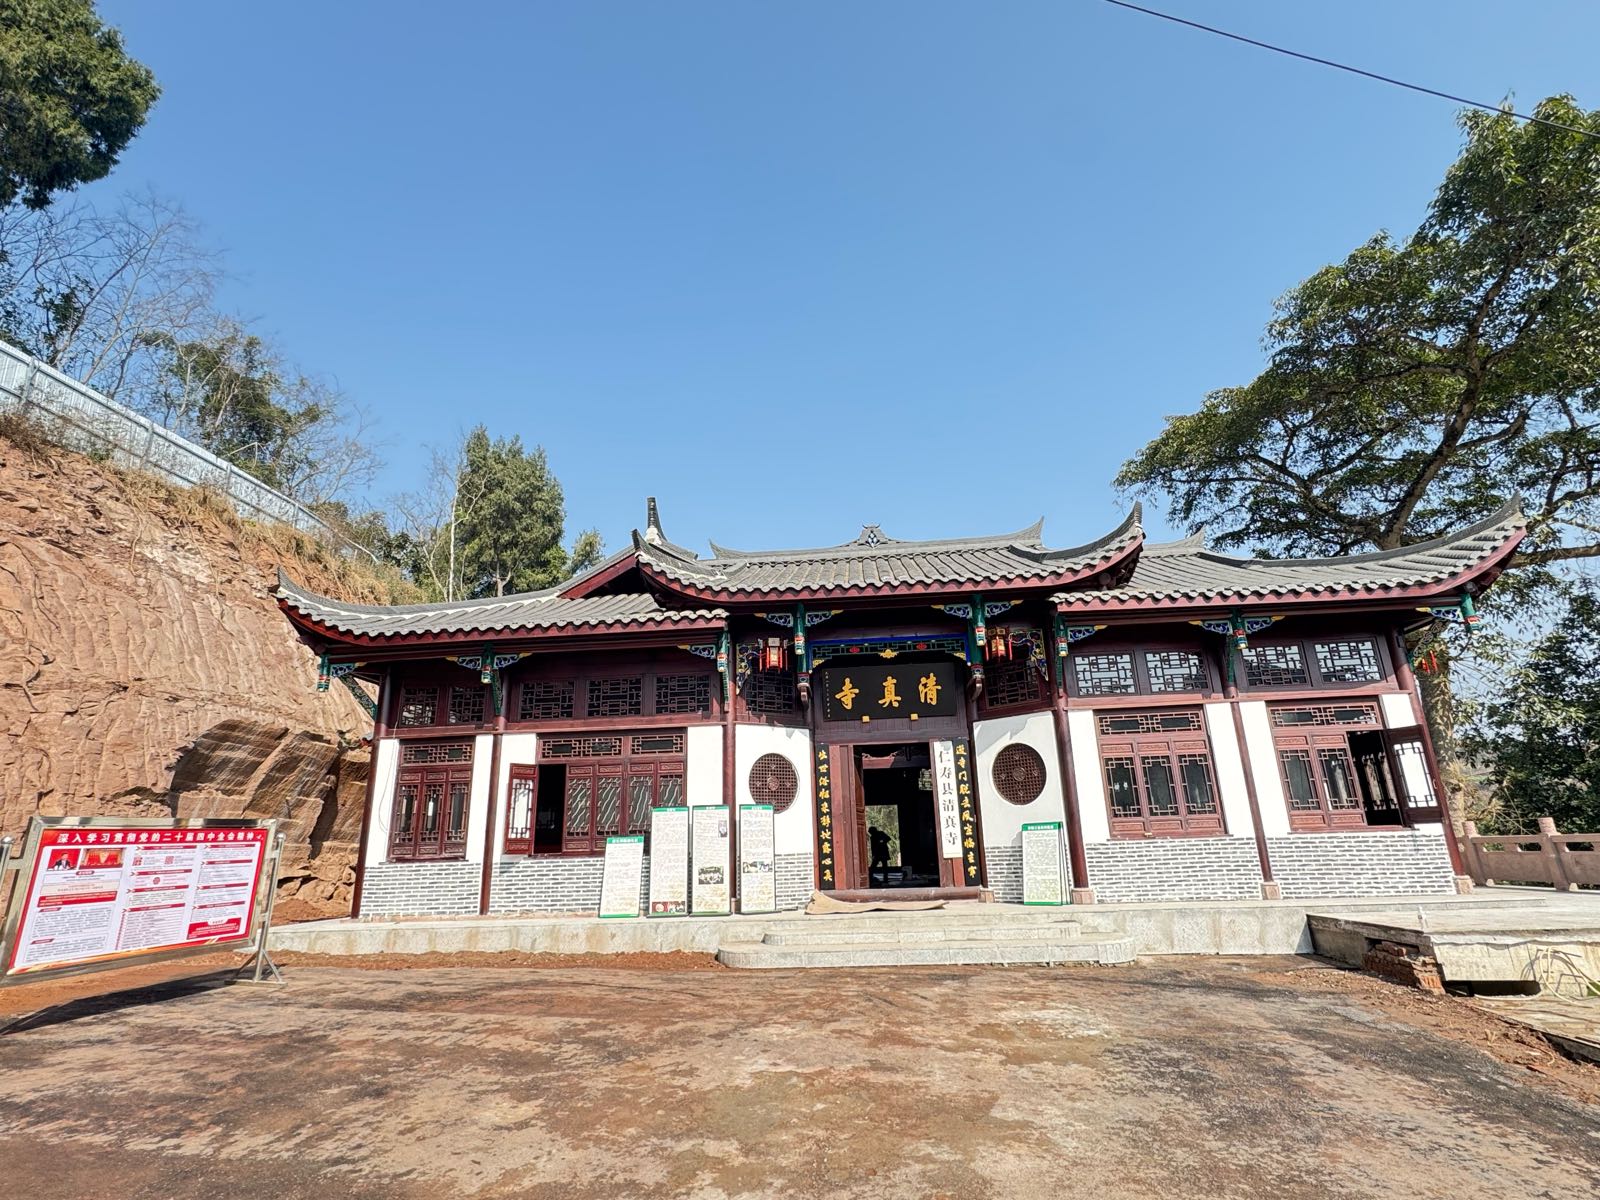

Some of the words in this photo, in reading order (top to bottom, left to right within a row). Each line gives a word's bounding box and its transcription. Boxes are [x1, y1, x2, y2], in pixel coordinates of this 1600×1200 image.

[834, 672, 943, 710] 清真寺
[939, 750, 958, 846] 仁寿县清真寺
[56, 831, 254, 844] 深入学习贯彻党的二十届四中全会精神
